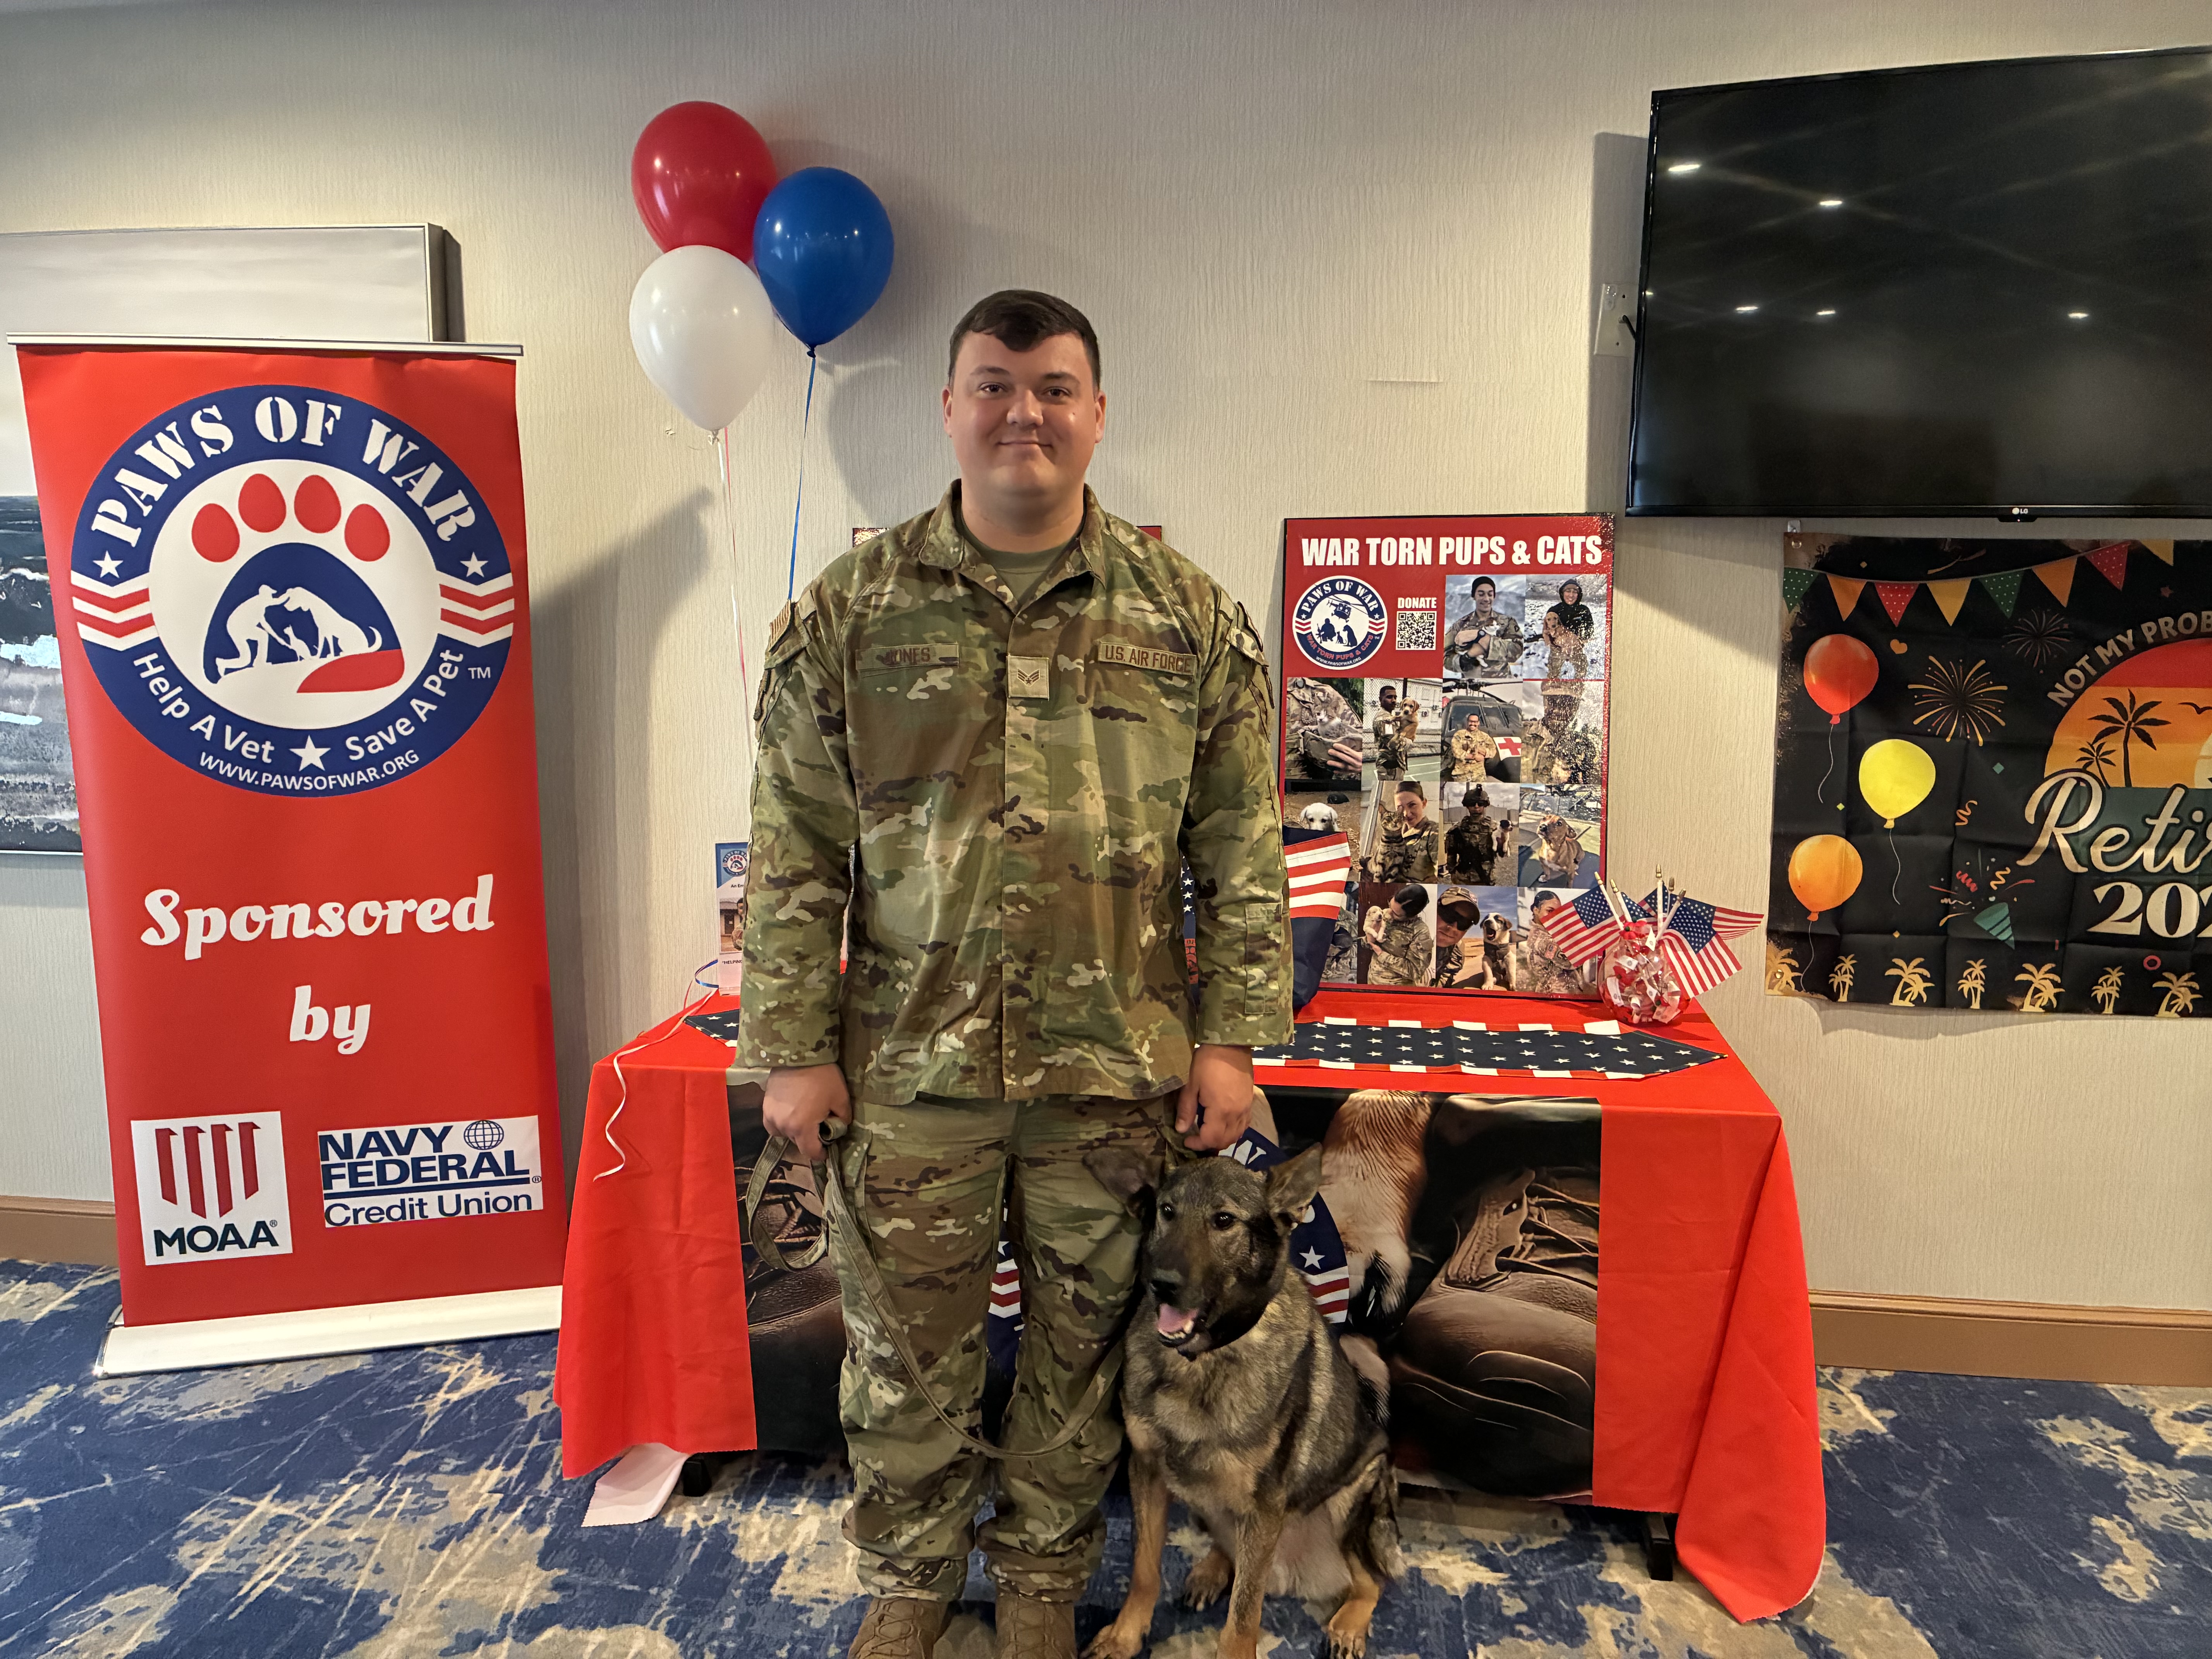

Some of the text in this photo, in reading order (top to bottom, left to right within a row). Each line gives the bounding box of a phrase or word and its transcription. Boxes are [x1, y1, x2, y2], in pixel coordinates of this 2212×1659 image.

[91, 397, 476, 547] PAWS OF WAR
[1301, 535, 1602, 566] WAR TORN PUPS & CATS
[1301, 581, 1379, 613] PAWS OF WAR
[1397, 597, 1437, 609] DONATE
[1129, 648, 1149, 666] AIR
[1153, 652, 1192, 672] FORCE
[1307, 634, 1317, 649] WAR
[1317, 647, 1334, 660] TORN
[2047, 611, 2212, 708] NOT MY PROB
[134, 649, 465, 764] Help A Vet Save A Pet
[199, 750, 420, 791] WWW.PAWSOFWAR.ORG
[2016, 772, 2212, 873] Reti
[141, 874, 495, 960] Sponsored
[2087, 882, 2212, 938] 20
[289, 985, 371, 1054] by
[318, 1125, 453, 1161] NAVY
[321, 1149, 530, 1190] FEDERAL
[324, 1192, 532, 1227] Credit Union
[154, 1220, 278, 1256] MOAA
